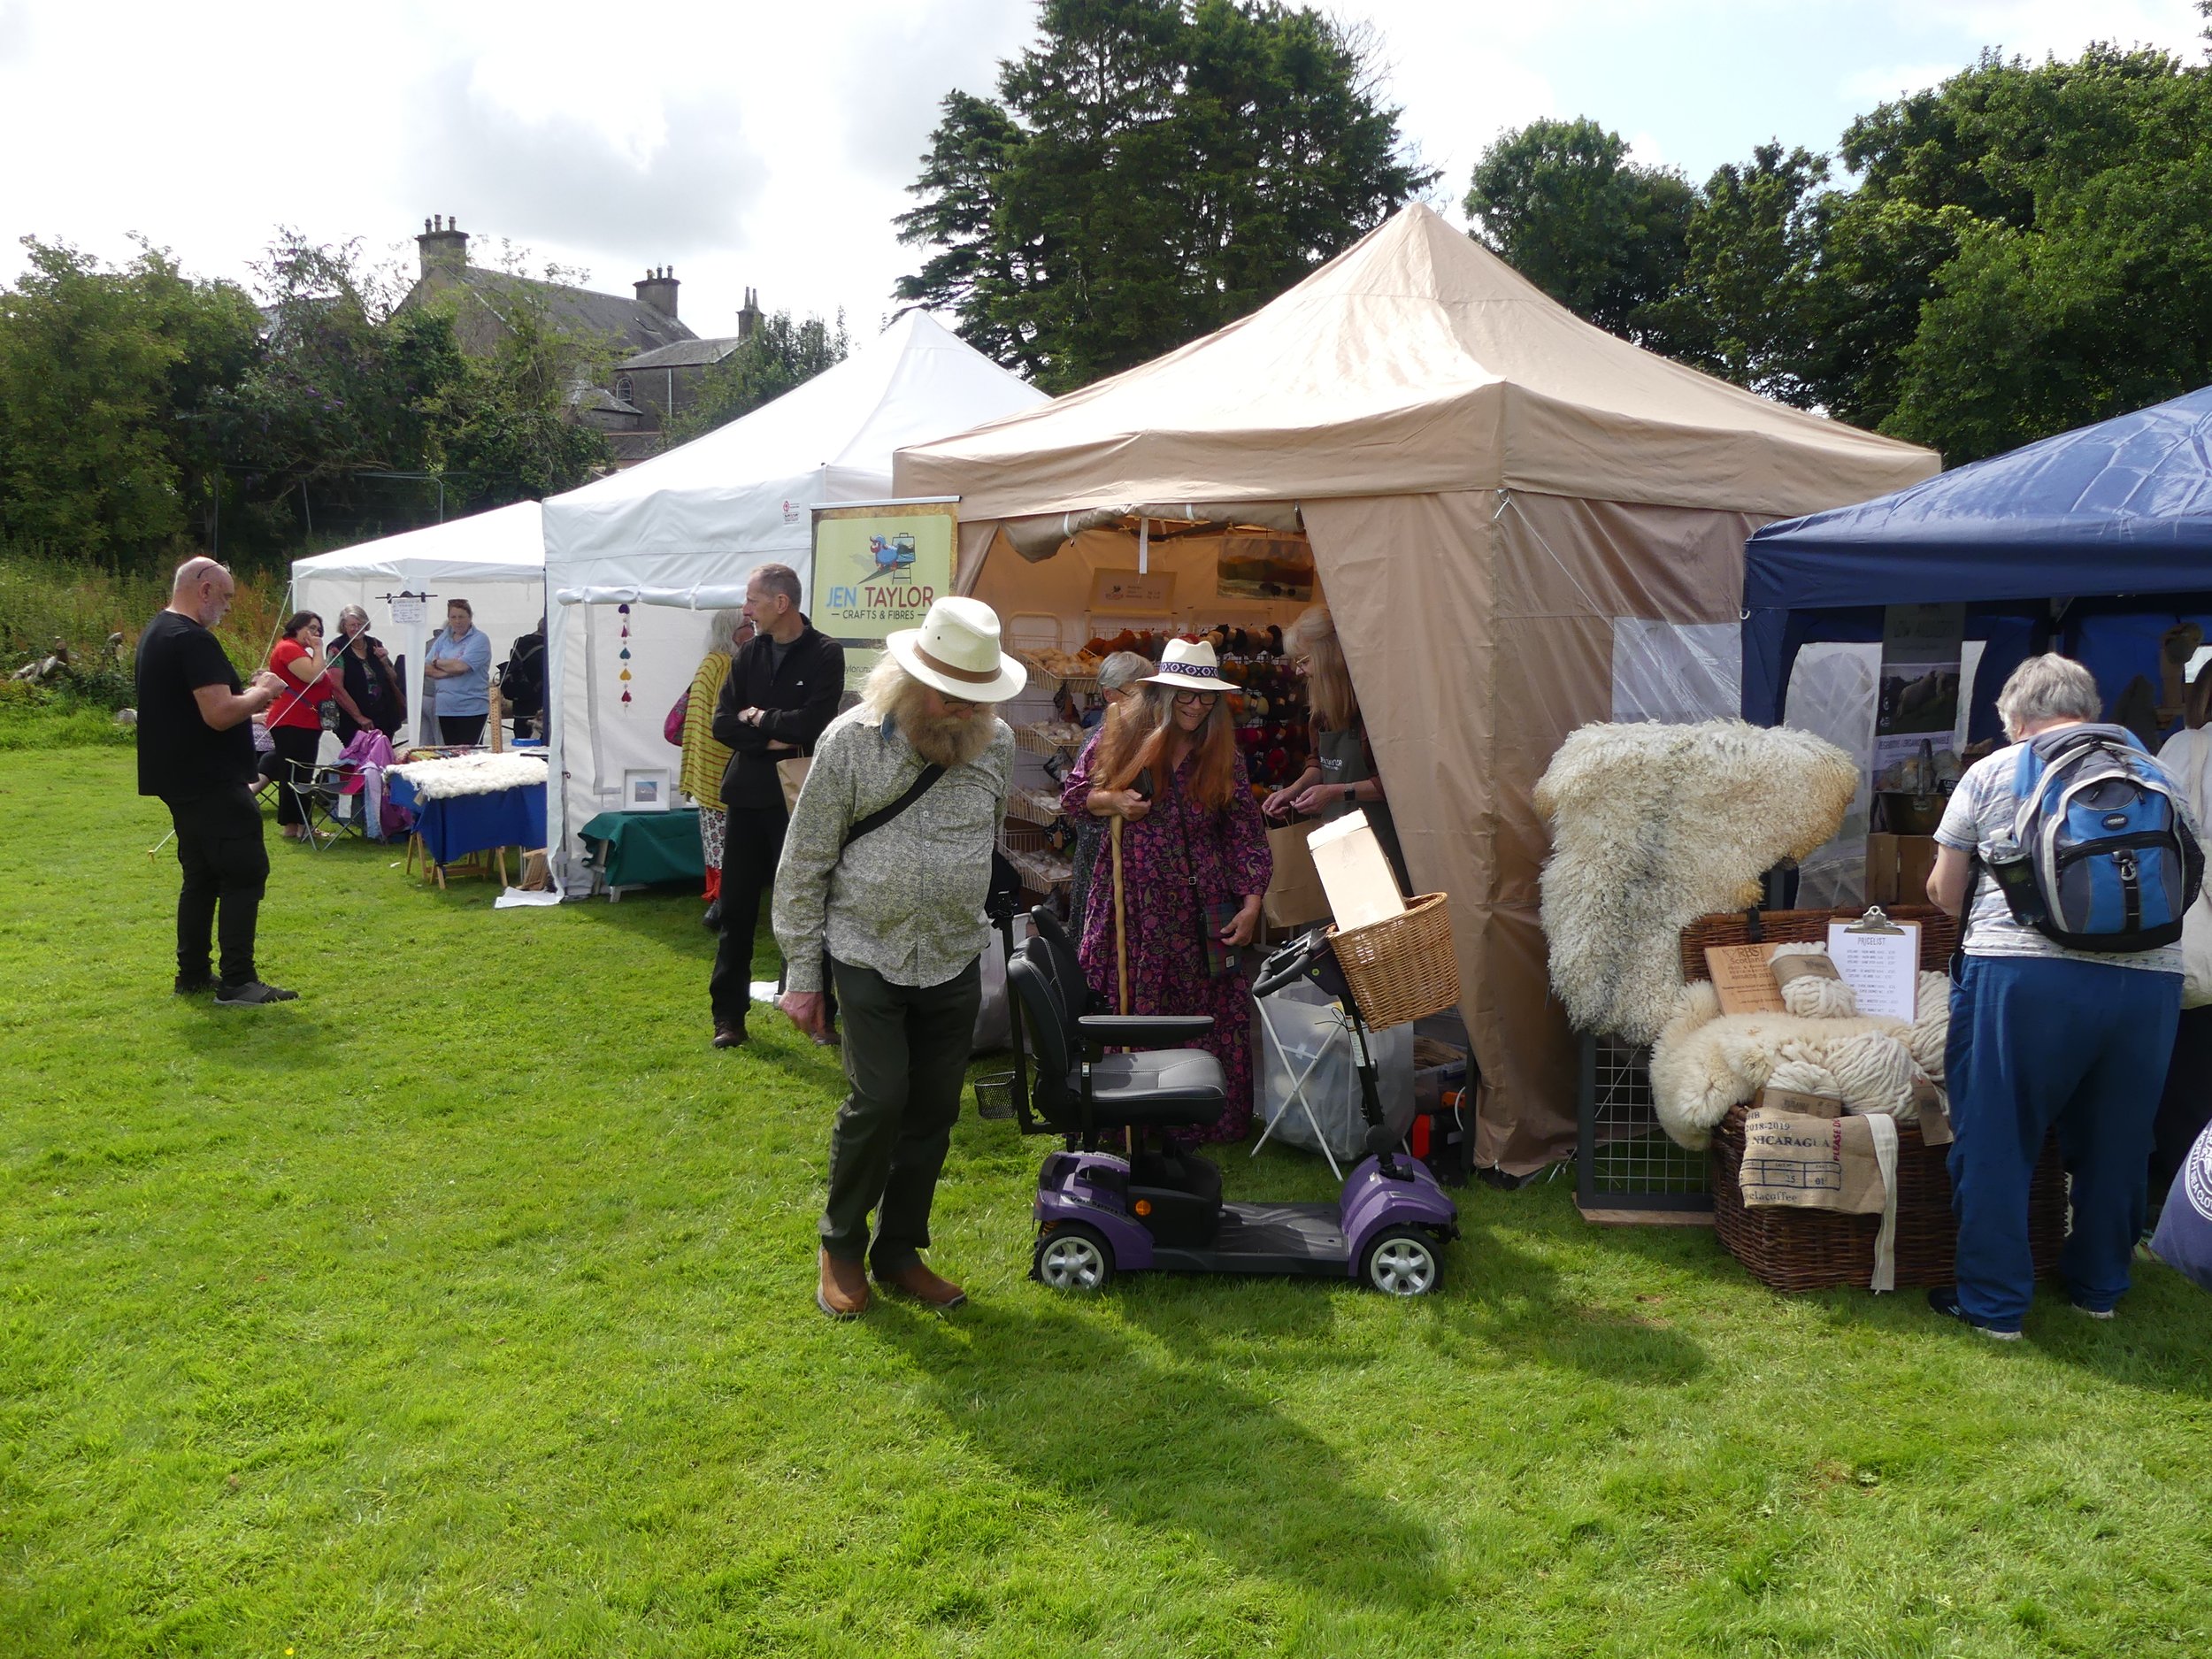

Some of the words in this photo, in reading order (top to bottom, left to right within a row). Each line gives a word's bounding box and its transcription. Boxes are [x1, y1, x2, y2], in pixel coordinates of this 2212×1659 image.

[826, 587, 856, 607] JEN
[864, 587, 933, 607] TAYLOR
[842, 610, 877, 619] CRAFTS
[879, 611, 886, 619] &
[887, 611, 915, 619] FIBRES
[1857, 937, 1886, 946] PRICELIST
[1752, 1136, 1830, 1148] NICARAGUA
